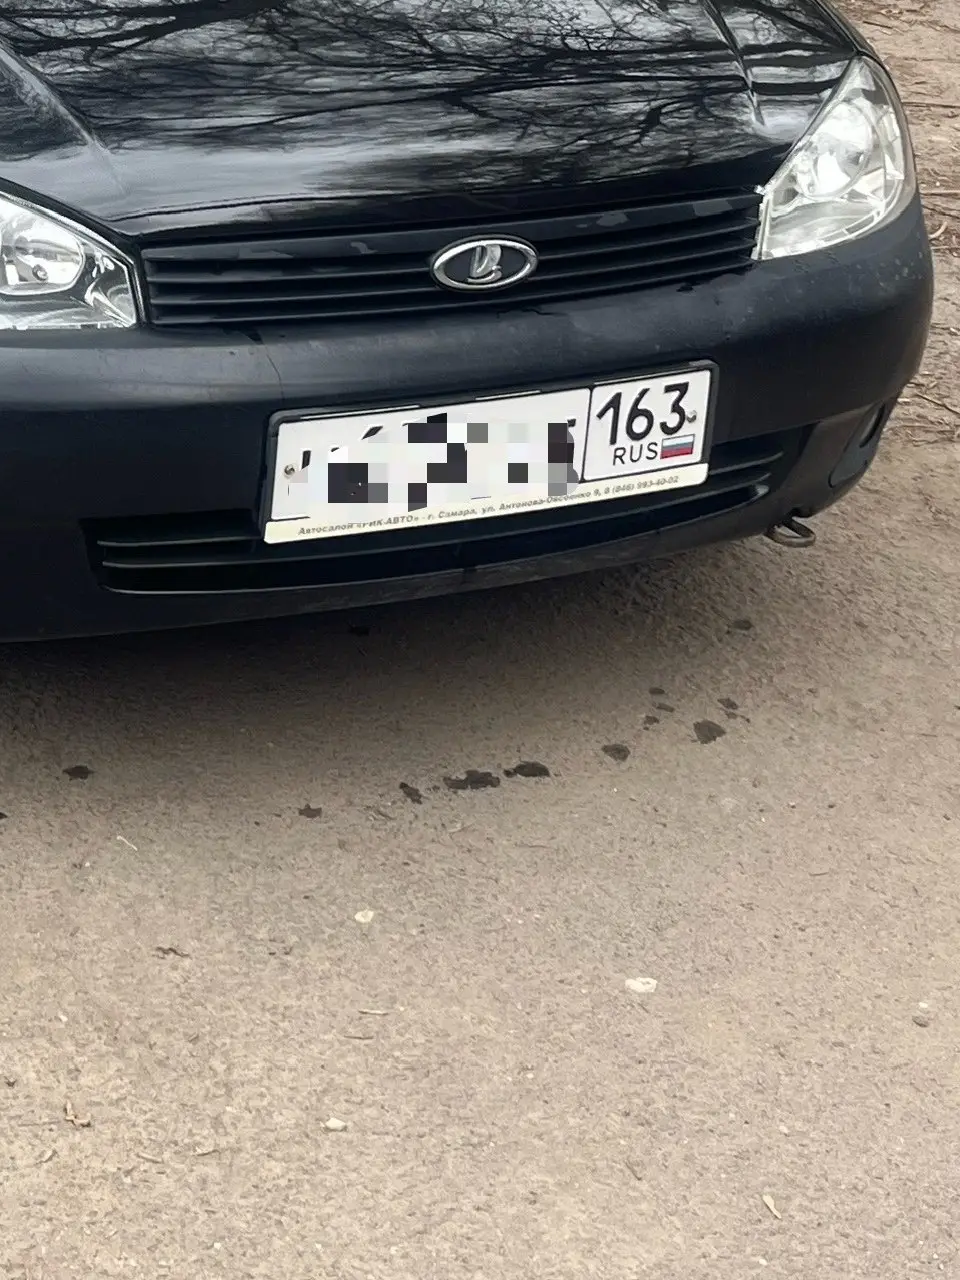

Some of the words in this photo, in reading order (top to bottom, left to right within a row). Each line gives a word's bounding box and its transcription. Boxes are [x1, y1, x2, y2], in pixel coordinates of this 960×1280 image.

[596, 381, 690, 445] 163
[613, 442, 659, 466] RUS
[298, 523, 353, 535] Автосалон
